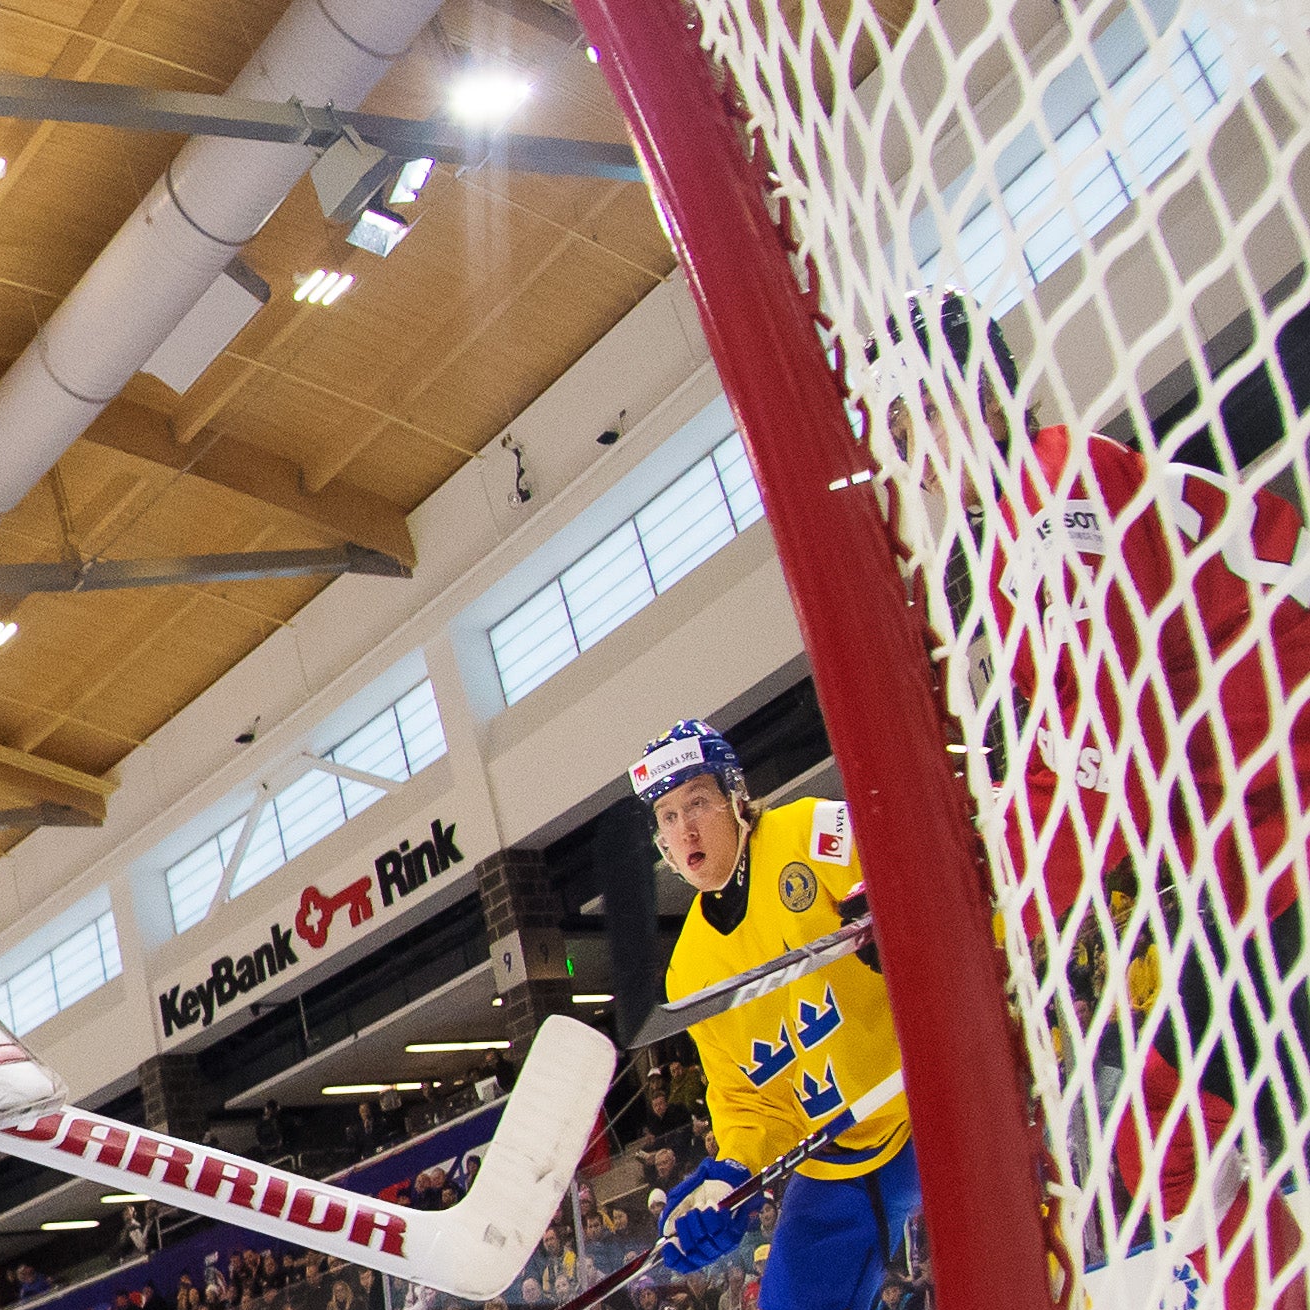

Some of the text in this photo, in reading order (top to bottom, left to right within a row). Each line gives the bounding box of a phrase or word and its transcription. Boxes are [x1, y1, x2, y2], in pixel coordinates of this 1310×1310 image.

[158, 818, 466, 1038] KeyBank Rink
[502, 952, 512, 973] 9
